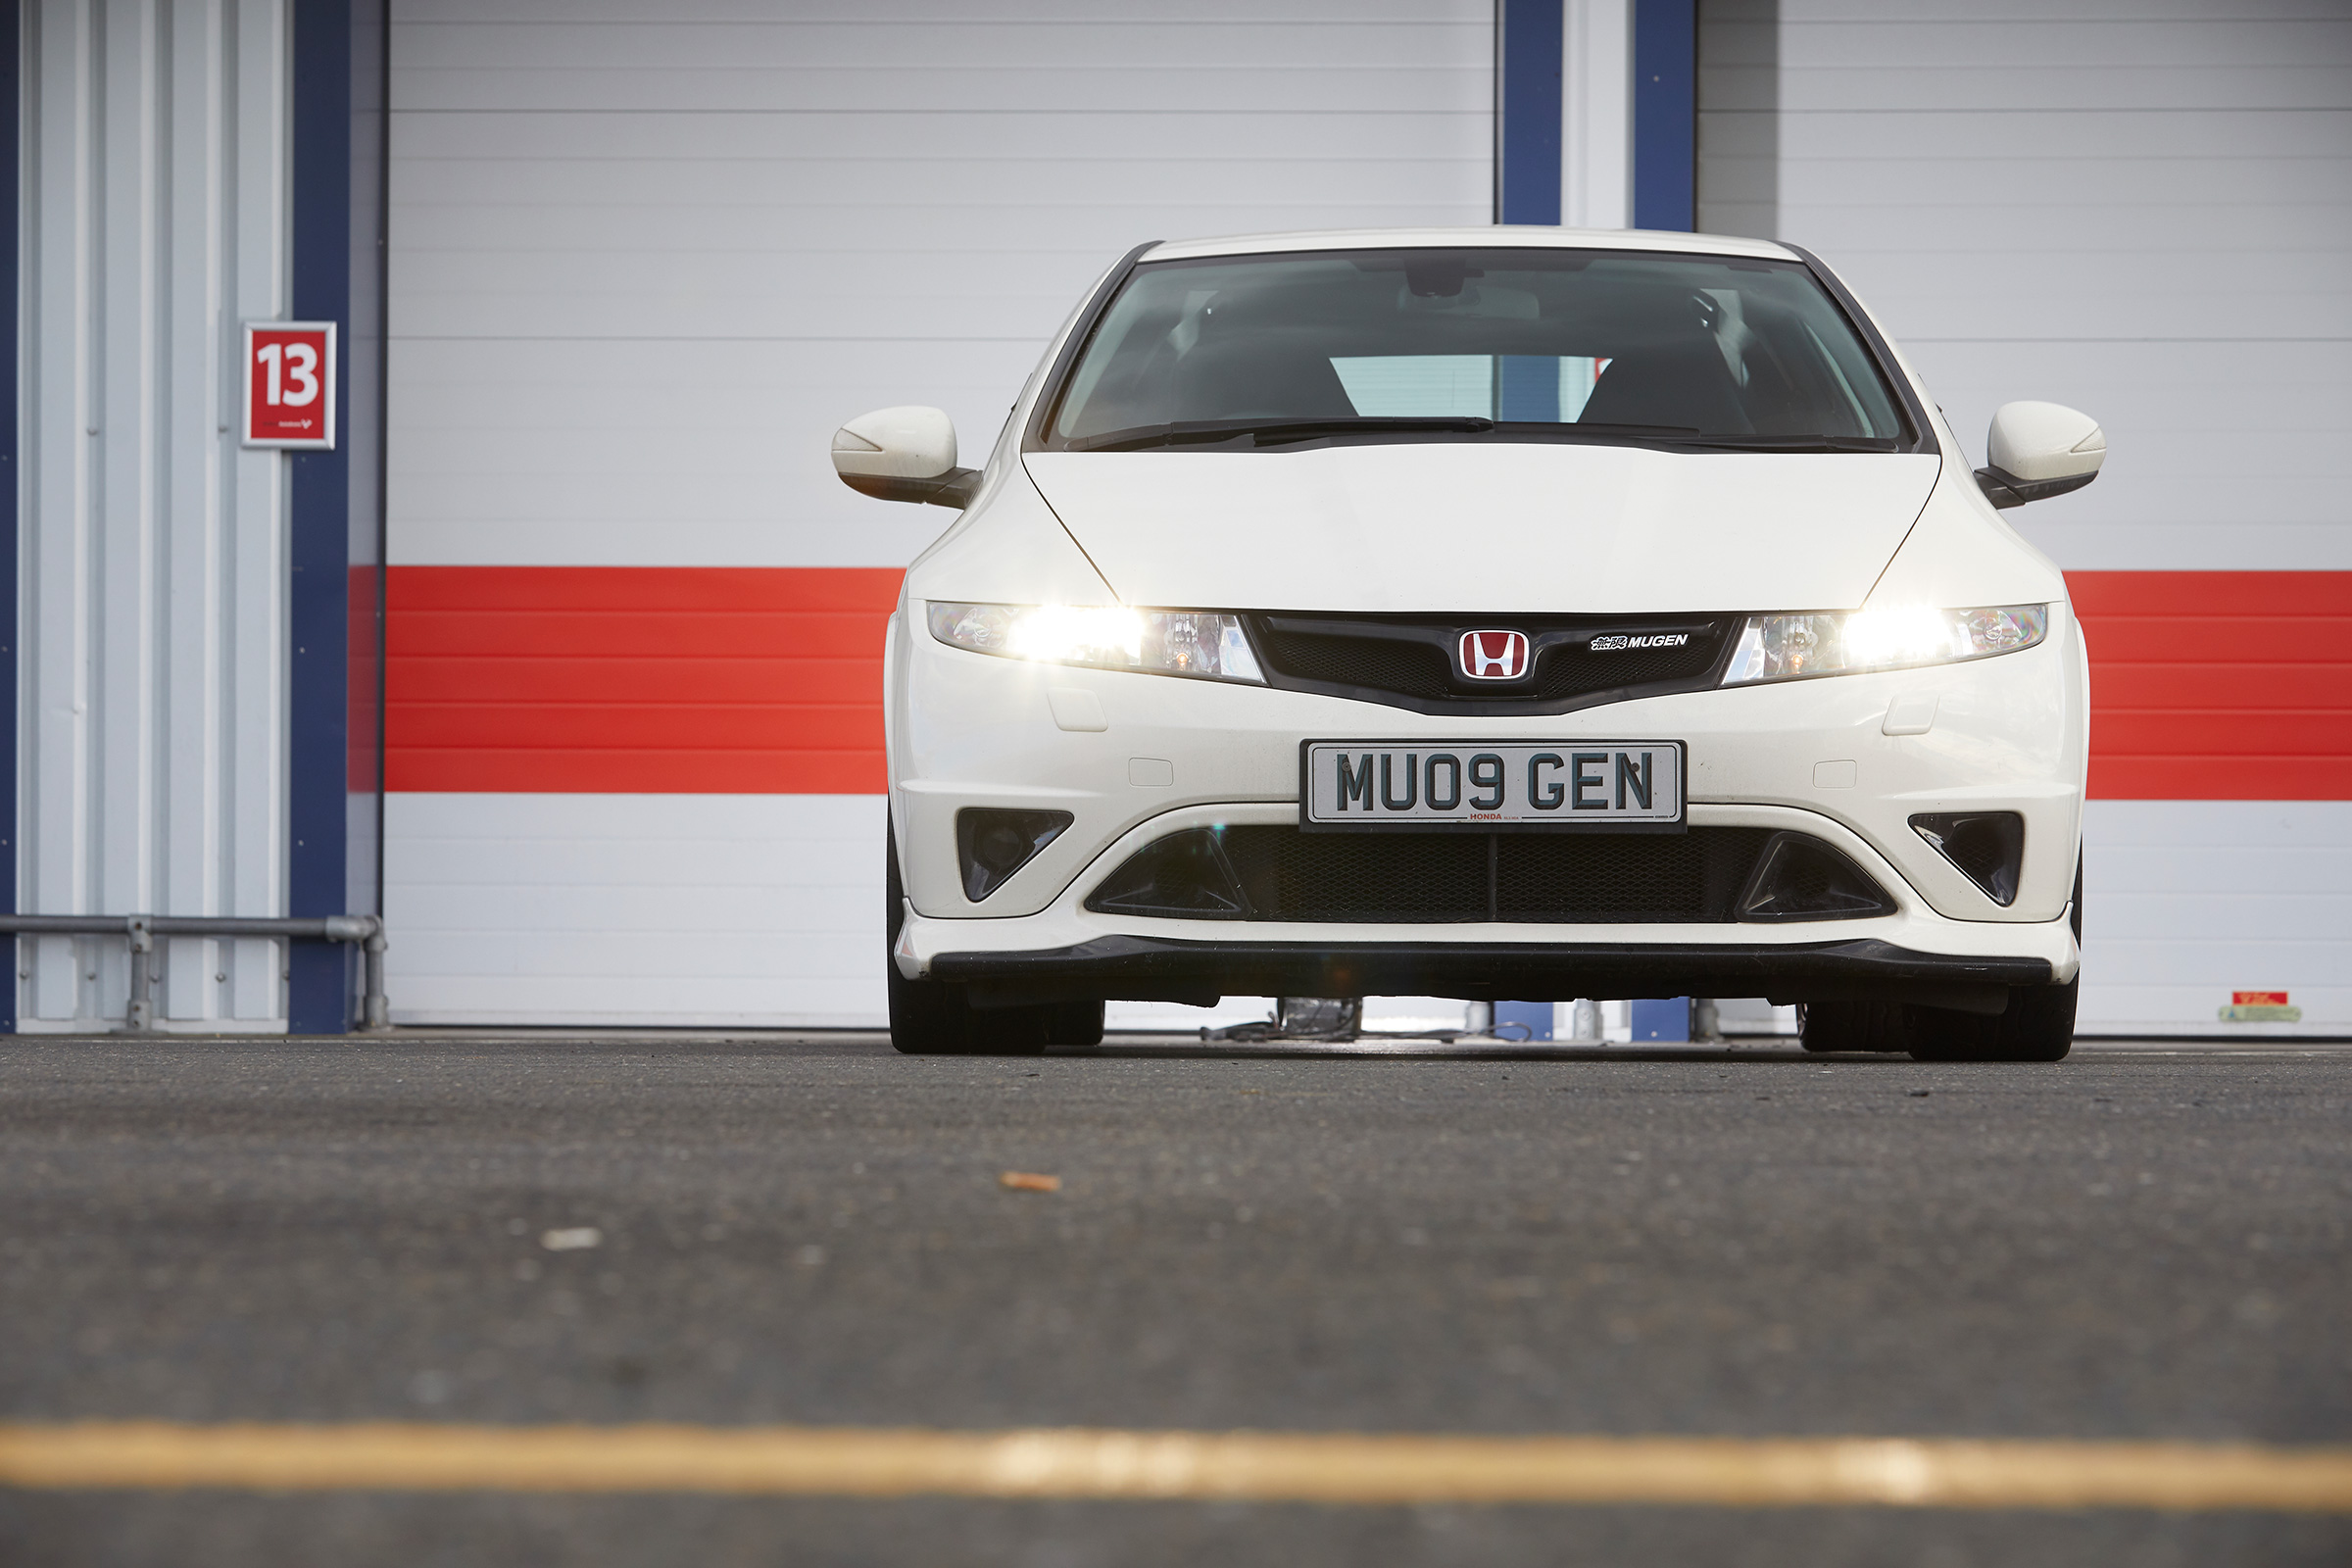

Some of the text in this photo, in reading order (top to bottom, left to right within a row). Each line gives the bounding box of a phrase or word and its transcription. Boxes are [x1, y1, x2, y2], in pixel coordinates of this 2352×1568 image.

[257, 343, 318, 407] 13
[1628, 634, 1689, 648] MUGEN
[1337, 752, 1653, 811] MU09 GEN
